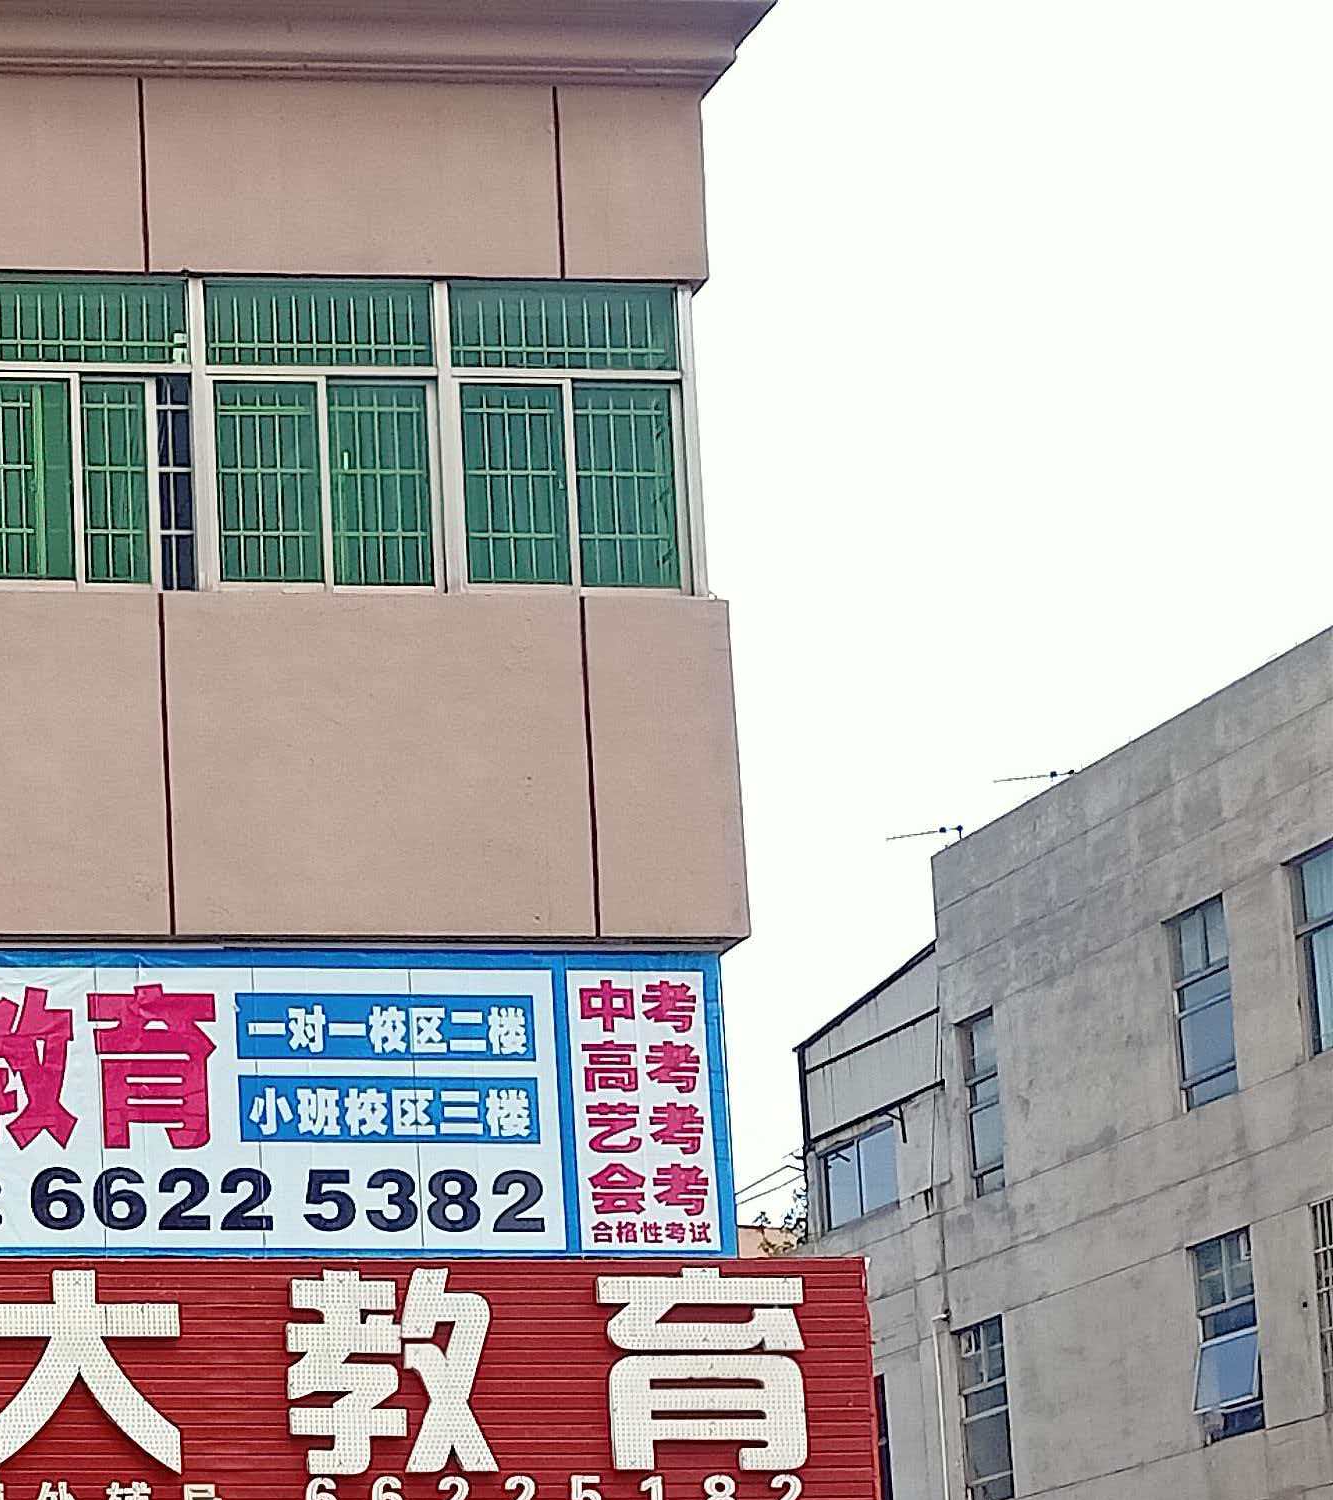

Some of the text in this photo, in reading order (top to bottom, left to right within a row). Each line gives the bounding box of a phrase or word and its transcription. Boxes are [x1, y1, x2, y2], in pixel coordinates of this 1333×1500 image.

[247, 1005, 527, 1056] 一对一校区二楼
[578, 979, 697, 1034] 中考
[582, 1040, 702, 1095] 高考
[247, 1087, 533, 1139] 小班校区三楼
[586, 1101, 707, 1156] 艺考
[32, 1166, 274, 1232] 6622
[303, 1168, 547, 1234] 5382
[587, 1161, 710, 1217] 会考
[590, 1220, 713, 1245] 合格性考试
